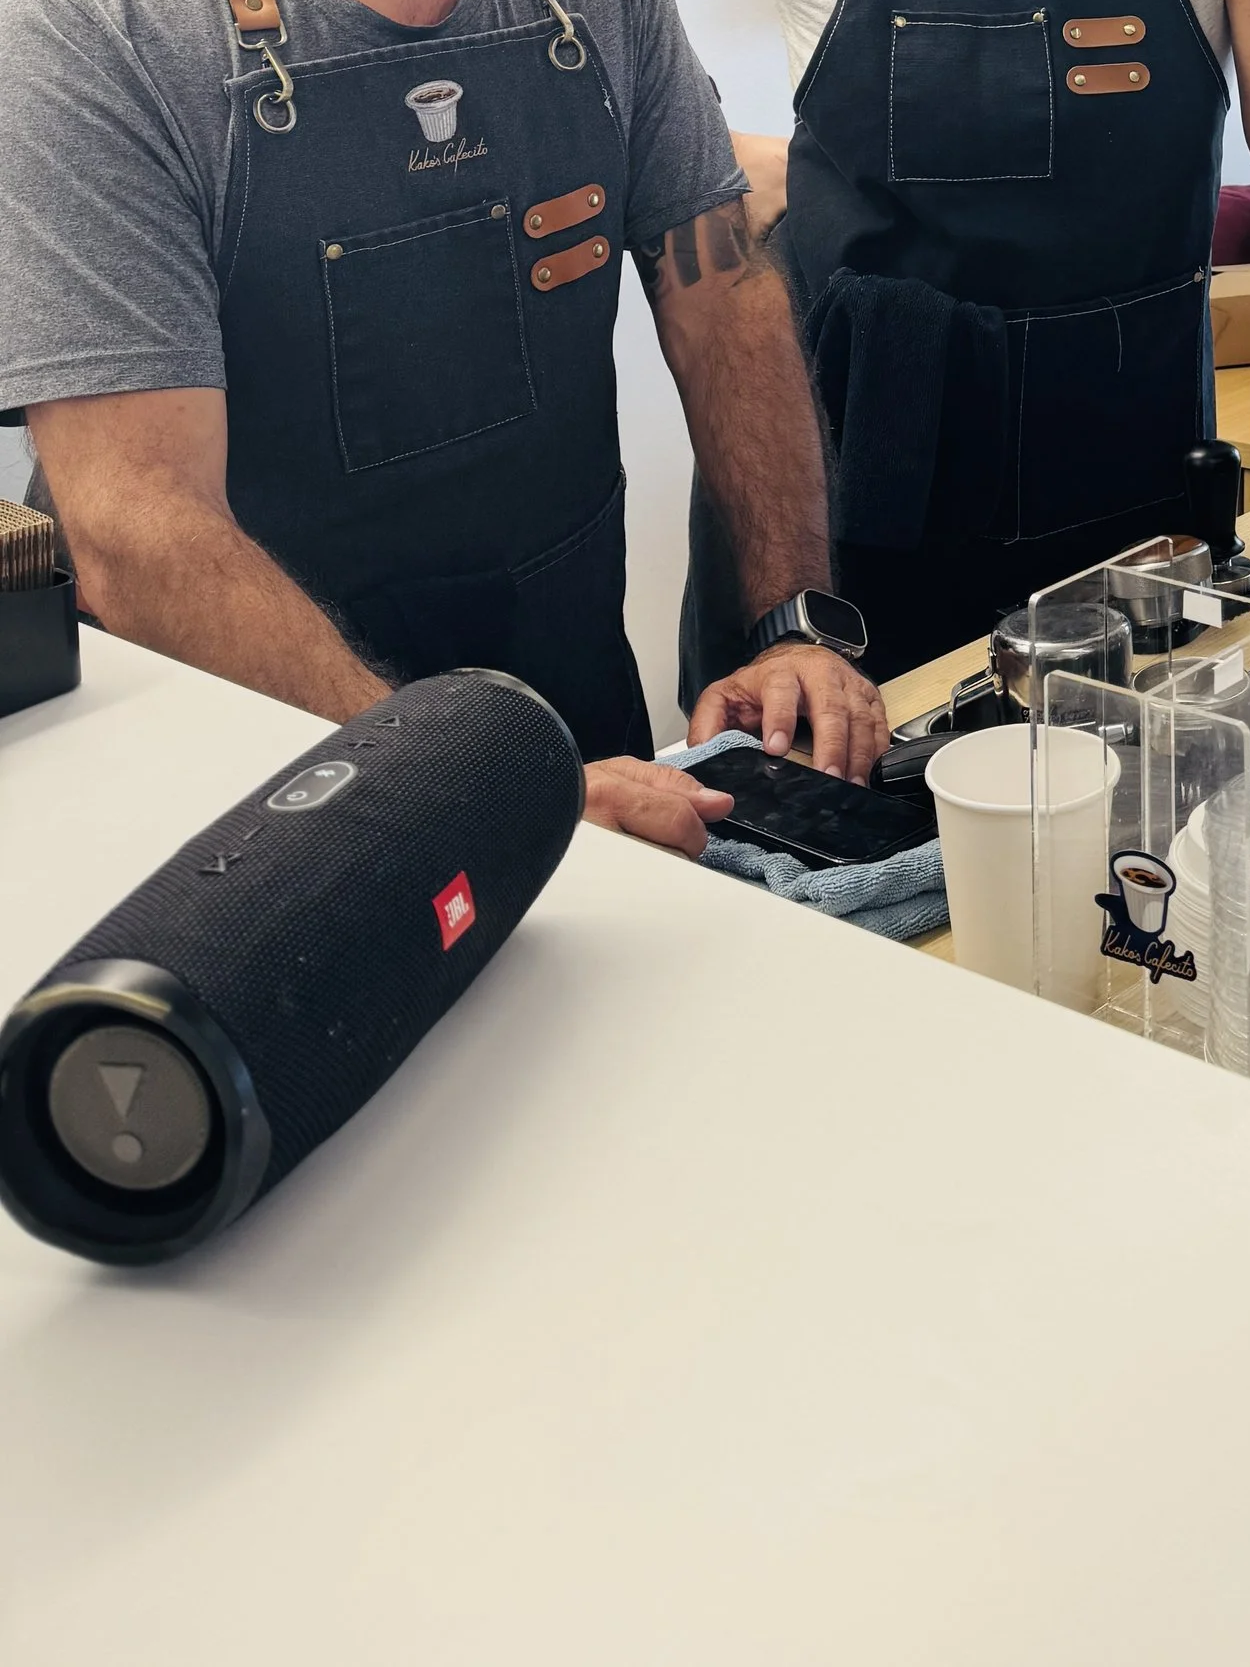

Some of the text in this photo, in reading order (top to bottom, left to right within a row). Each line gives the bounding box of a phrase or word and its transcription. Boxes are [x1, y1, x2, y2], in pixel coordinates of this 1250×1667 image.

[443, 137, 488, 173] Cafecito
[444, 891, 469, 928] JBL
[1144, 941, 1194, 980] Cafecito
